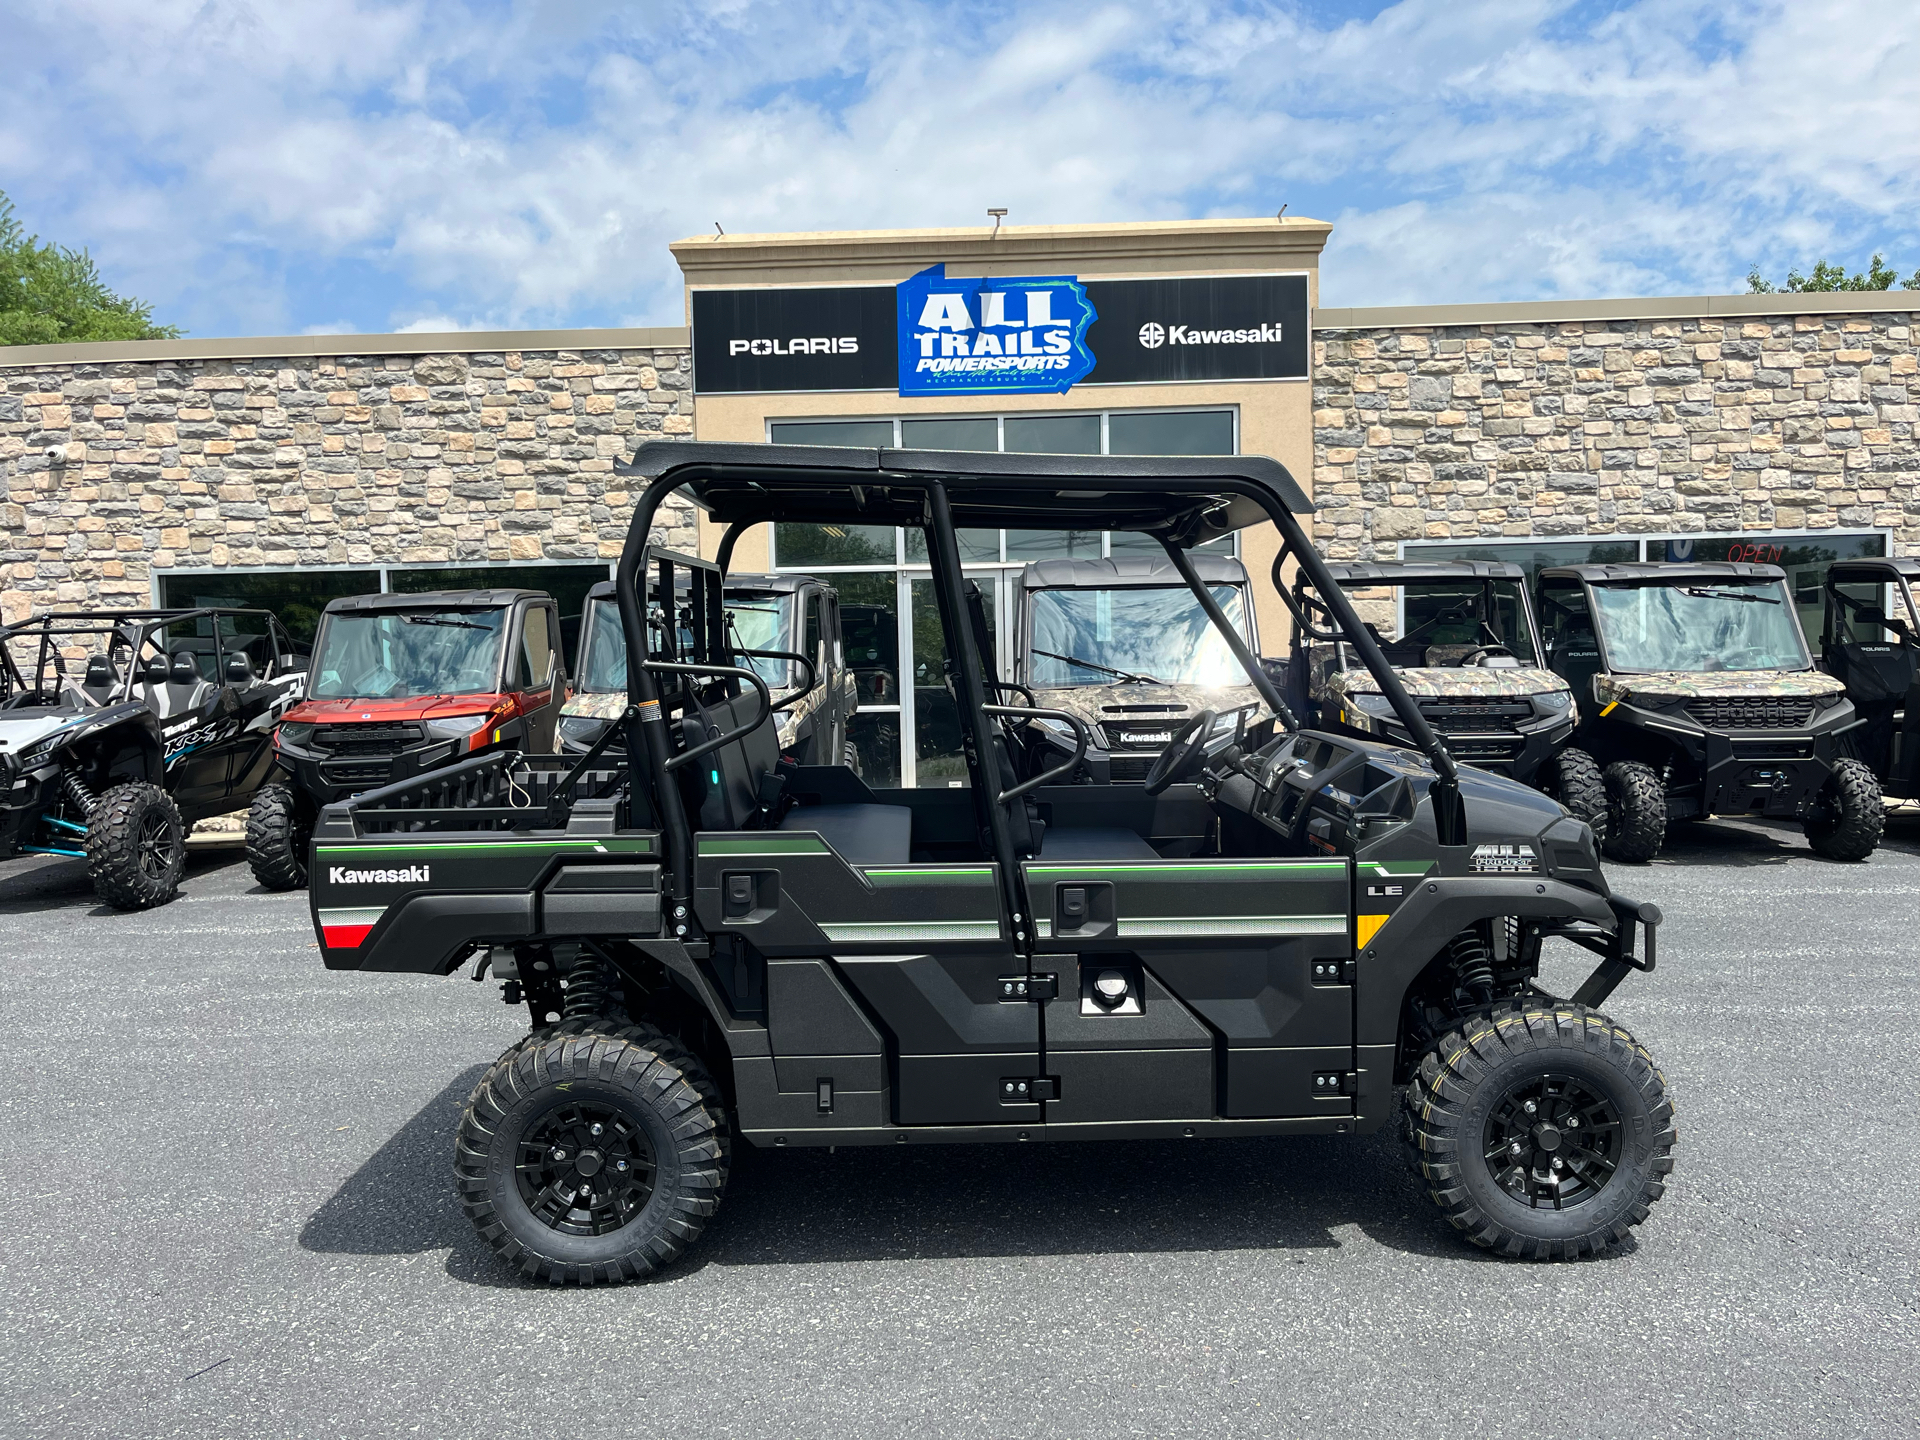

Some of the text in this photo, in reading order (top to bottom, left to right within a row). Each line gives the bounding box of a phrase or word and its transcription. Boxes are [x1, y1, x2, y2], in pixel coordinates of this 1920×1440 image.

[918, 291, 1071, 332] ALL
[914, 329, 1072, 357] TRAILS
[1169, 323, 1282, 345] Kawasaki
[729, 337, 859, 356] POLARIS
[915, 355, 1071, 373] POWERSPORTS
[1727, 543, 1784, 563] OPEN
[1716, 707, 1796, 718] POLARIS
[1120, 732, 1172, 742] Kawasaki
[1469, 845, 1538, 859] MULE
[329, 865, 430, 884] Kawasaki
[1367, 886, 1403, 896] LE
